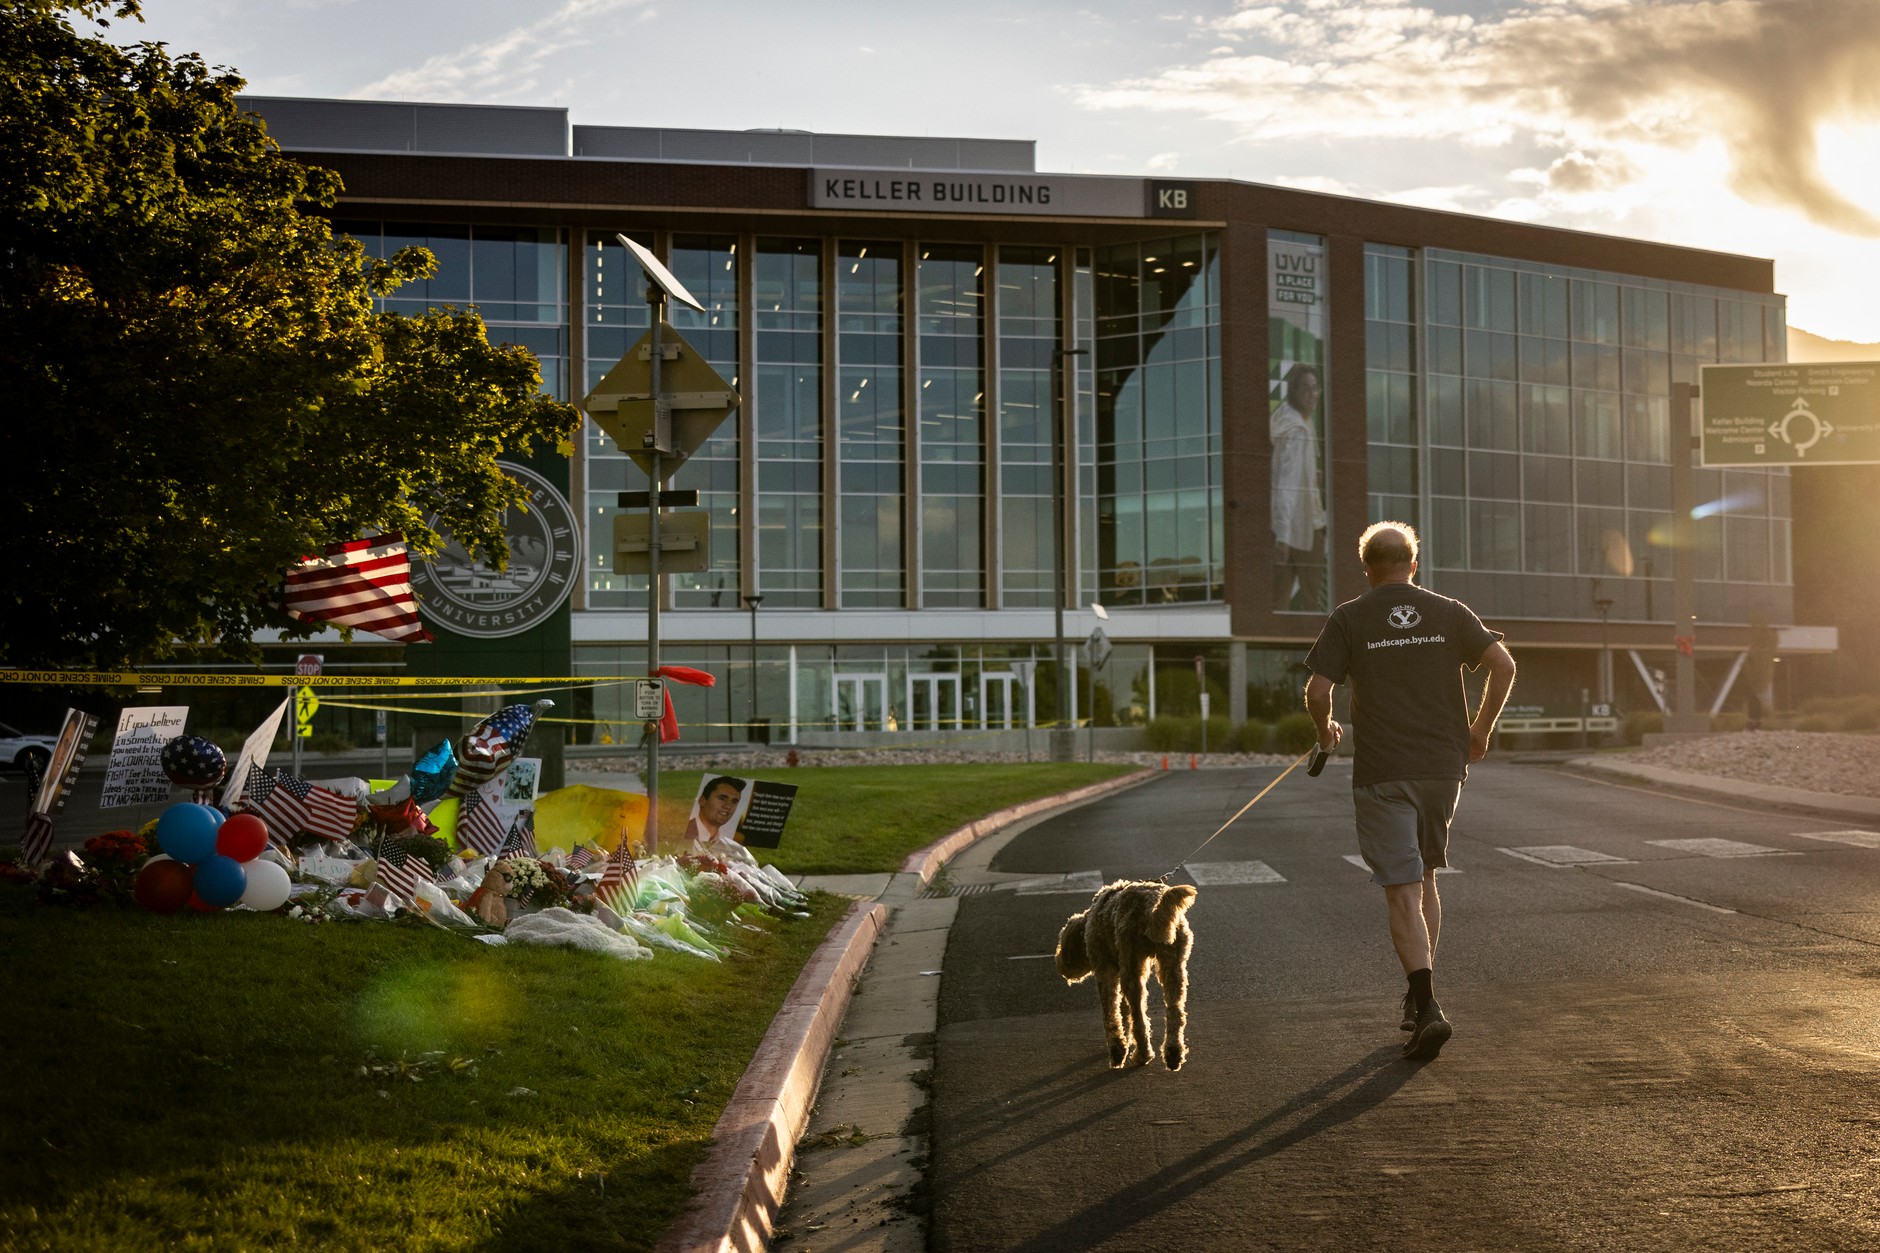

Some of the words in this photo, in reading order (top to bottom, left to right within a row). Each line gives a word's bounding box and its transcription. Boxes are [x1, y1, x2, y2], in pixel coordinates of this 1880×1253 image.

[826, 180, 922, 202] KELLER
[933, 184, 1051, 205] BUILDING
[1159, 190, 1187, 208] KB
[1275, 253, 1315, 273] UVU
[1278, 275, 1284, 285] A
[1286, 276, 1312, 288] PLACE
[1278, 290, 1295, 301] FOR
[1296, 292, 1314, 304] YOU
[1753, 369, 1783, 377] Student
[1784, 369, 1798, 377] Life
[1774, 378, 1799, 386] Center
[1773, 387, 1796, 395] Visitor
[1798, 386, 1826, 396] Parking
[1734, 418, 1764, 426] Building
[1740, 426, 1764, 434] Center
[432, 596, 544, 627] UNIVERSITY
[1367, 634, 1446, 650] landscape.byu.edu
[298, 665, 320, 675] STOP
[23, 672, 42, 682] NOT
[43, 672, 57, 682] DO
[59, 673, 90, 682] SCENE
[92, 674, 122, 683] CRIME
[140, 675, 170, 684] CROSS
[172, 676, 191, 684] NOT
[192, 676, 205, 684] DO
[208, 676, 236, 684] SCENE
[238, 676, 265, 684] CRIME
[281, 676, 310, 684] CROSS
[311, 676, 330, 684] NOT
[374, 677, 400, 685] CRIME
[1592, 704, 1610, 716] KB
[119, 714, 134, 732] if
[132, 722, 148, 737] you
[151, 712, 182, 727] believe
[115, 736, 126, 747] in
[112, 748, 126, 758] you
[126, 746, 142, 754] need
[110, 758, 122, 769] the
[122, 755, 161, 768] COURAGE
[106, 768, 130, 783] FIGHT
[129, 768, 140, 778] for
[143, 768, 167, 779] those
[126, 778, 139, 786] NOT
